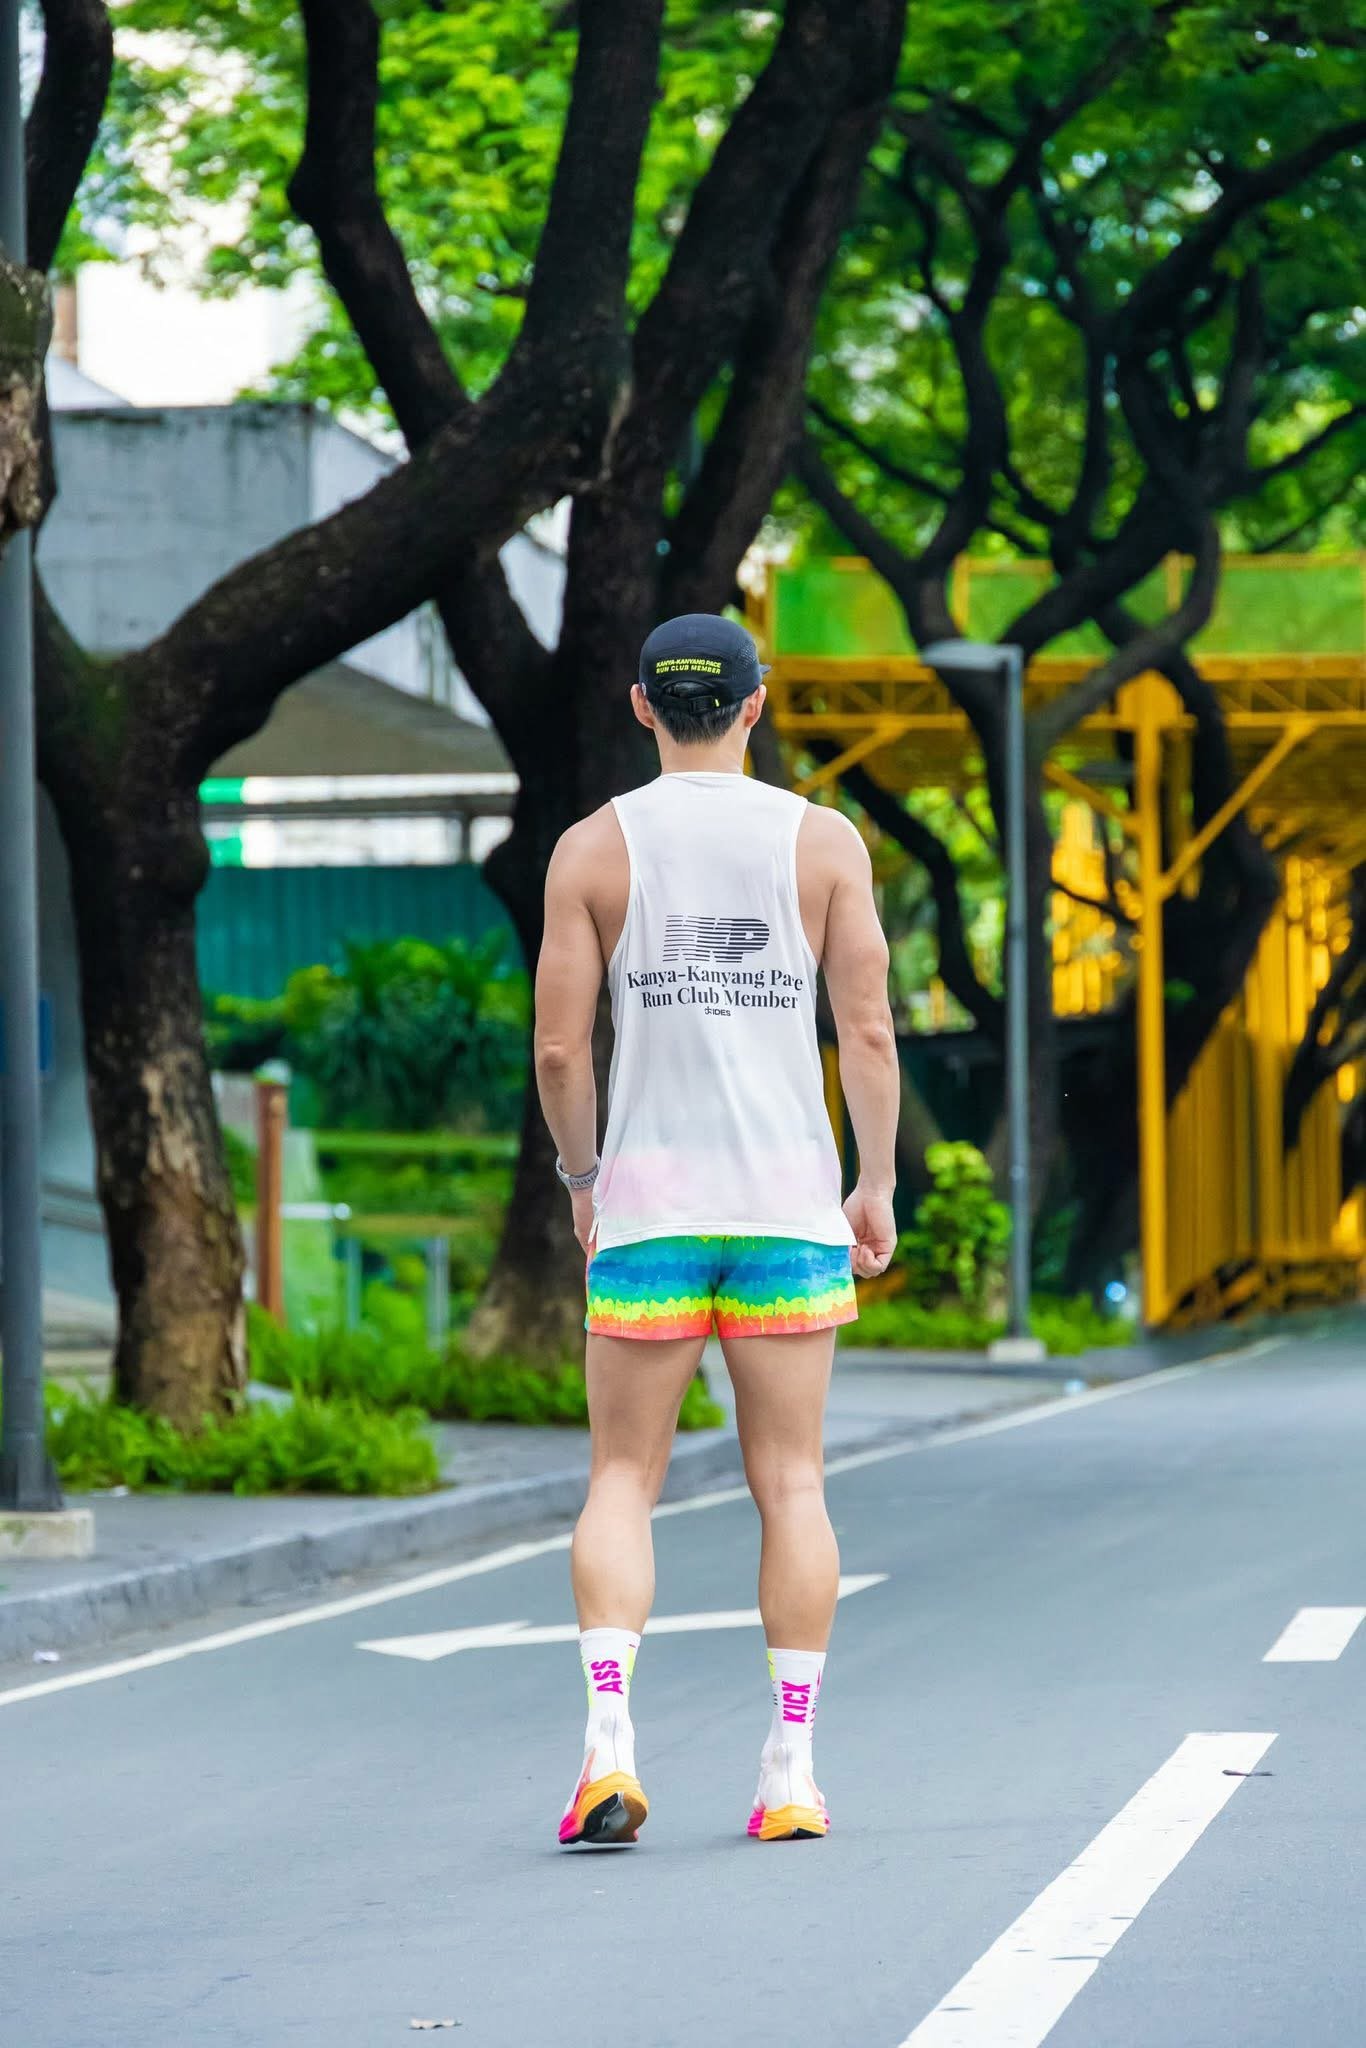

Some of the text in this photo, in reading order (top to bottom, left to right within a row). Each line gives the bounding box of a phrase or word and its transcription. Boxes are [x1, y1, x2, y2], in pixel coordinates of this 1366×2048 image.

[670, 664, 689, 672] CLUB
[690, 665, 721, 674] MEMBER
[705, 660, 721, 668] PACE
[627, 965, 803, 991] Kanya-Kanyang Pae
[642, 986, 798, 1009] Run Club Member
[590, 1660, 624, 1695] ASS
[781, 1680, 811, 1723] KICK
